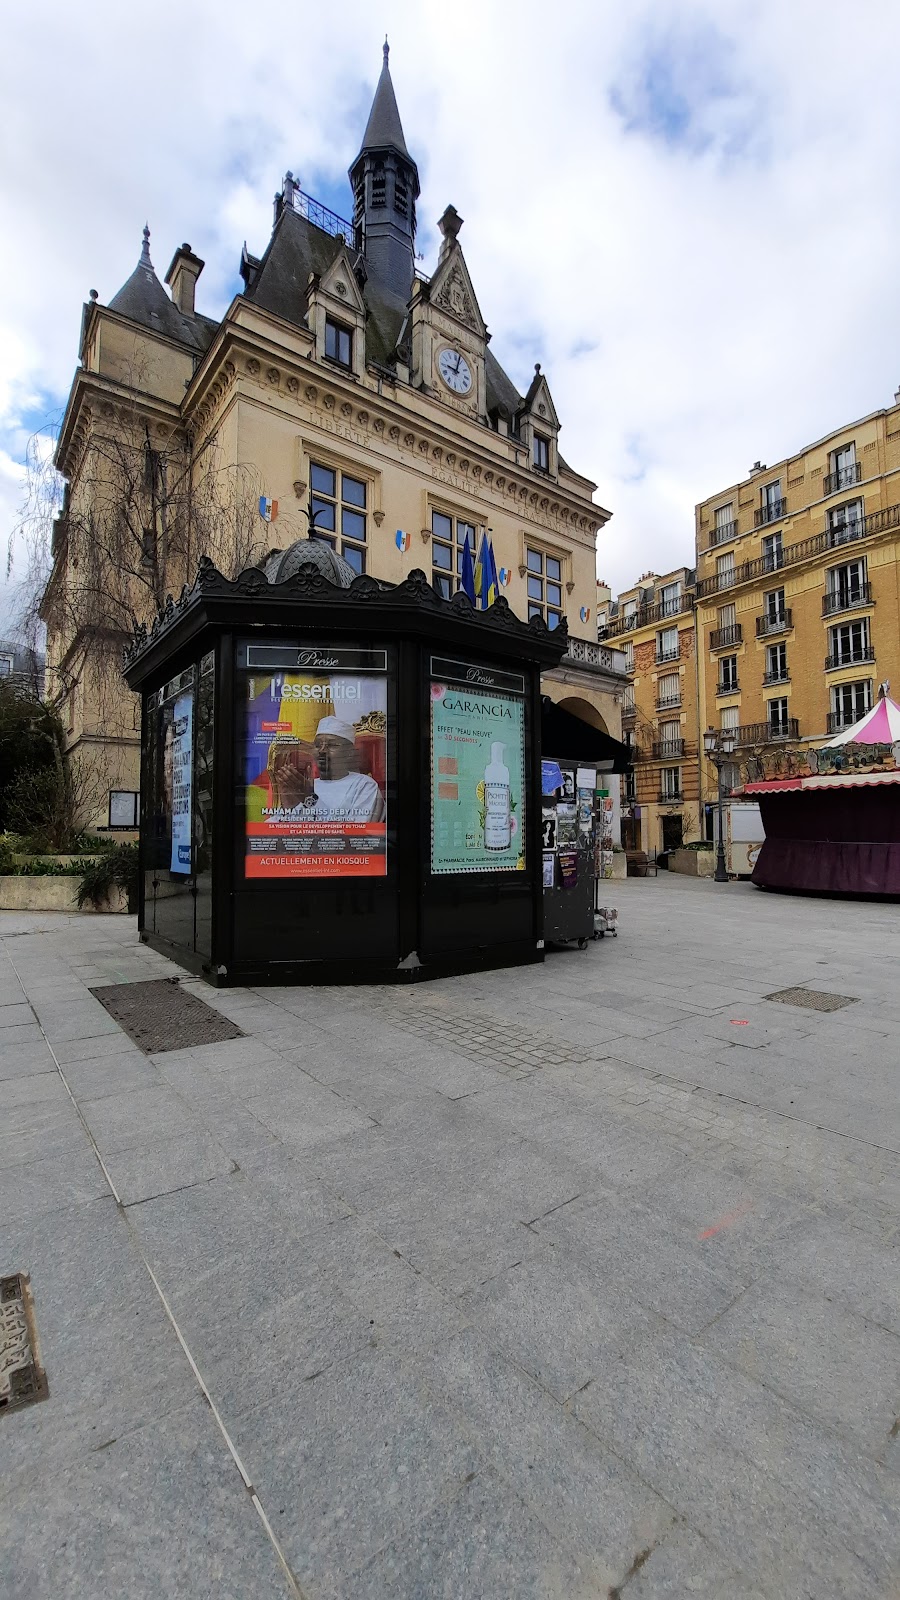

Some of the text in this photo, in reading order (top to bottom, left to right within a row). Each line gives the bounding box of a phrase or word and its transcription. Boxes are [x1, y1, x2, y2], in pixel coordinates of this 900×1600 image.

[297, 650, 340, 667] Presse
[466, 667, 495, 685] Presse
[270, 678, 361, 699] l'essentiel
[437, 725, 454, 734] EFFET
[261, 808, 302, 816] MAHAMAT
[302, 808, 328, 816] IDRISS
[351, 808, 370, 816] ITNO
[260, 857, 370, 865] ACTUELLEMENT EN KIOSQUE
